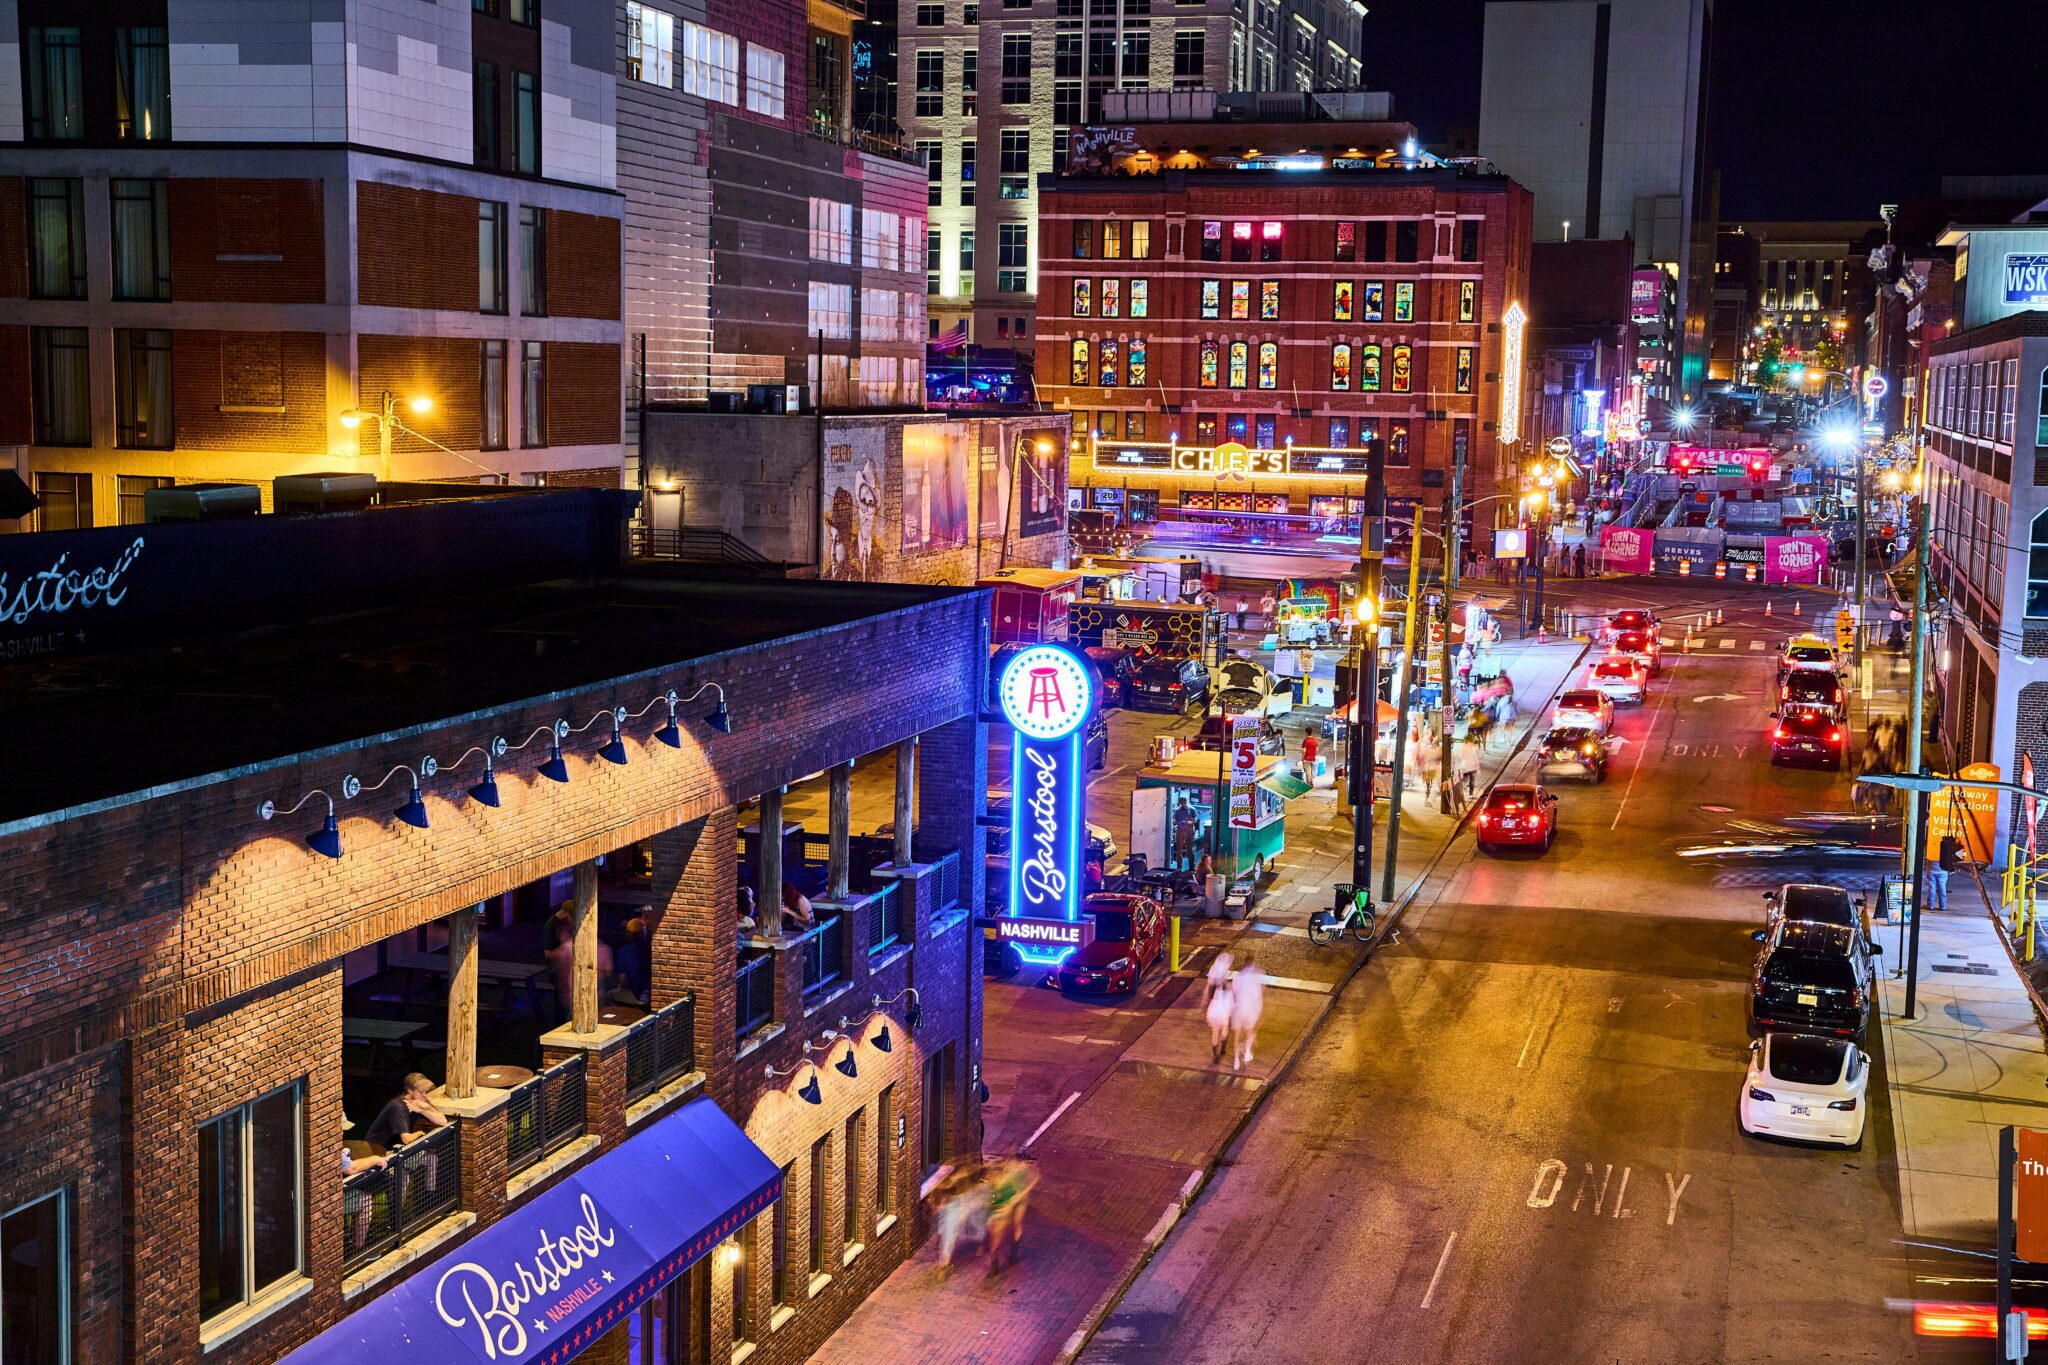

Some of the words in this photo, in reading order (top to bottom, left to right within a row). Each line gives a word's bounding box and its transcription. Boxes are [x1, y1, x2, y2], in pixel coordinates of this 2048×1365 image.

[1075, 129, 1134, 155] NASHVILLE
[1178, 450, 1283, 473] CHIEF'S
[1731, 453, 1751, 465] ON
[1718, 467, 1746, 475] Broadway
[1612, 530, 1629, 542] TURN
[1629, 532, 1641, 545] THE
[1610, 542, 1639, 557] CORNER
[1664, 546, 1702, 556] REEVES
[1779, 541, 1799, 555] TURN
[1799, 541, 1813, 554] THE
[1778, 553, 1813, 568] CORNER
[1235, 720, 1256, 729] PARK
[1234, 728, 1260, 740] HERE!
[1234, 741, 1255, 769] $5
[1672, 744, 1747, 759] ONLY
[1233, 777, 1253, 787] PARK
[1231, 785, 1256, 796] HERE!
[1232, 798, 1251, 807] PARK
[1231, 805, 1256, 817] HERE!
[1022, 747, 1066, 904] Barstool
[1001, 922, 1080, 942] NASHVILLE
[1526, 1158, 1692, 1226] ONLY
[435, 1193, 615, 1360] Barstool
[546, 1277, 603, 1324] NASHVILLE
